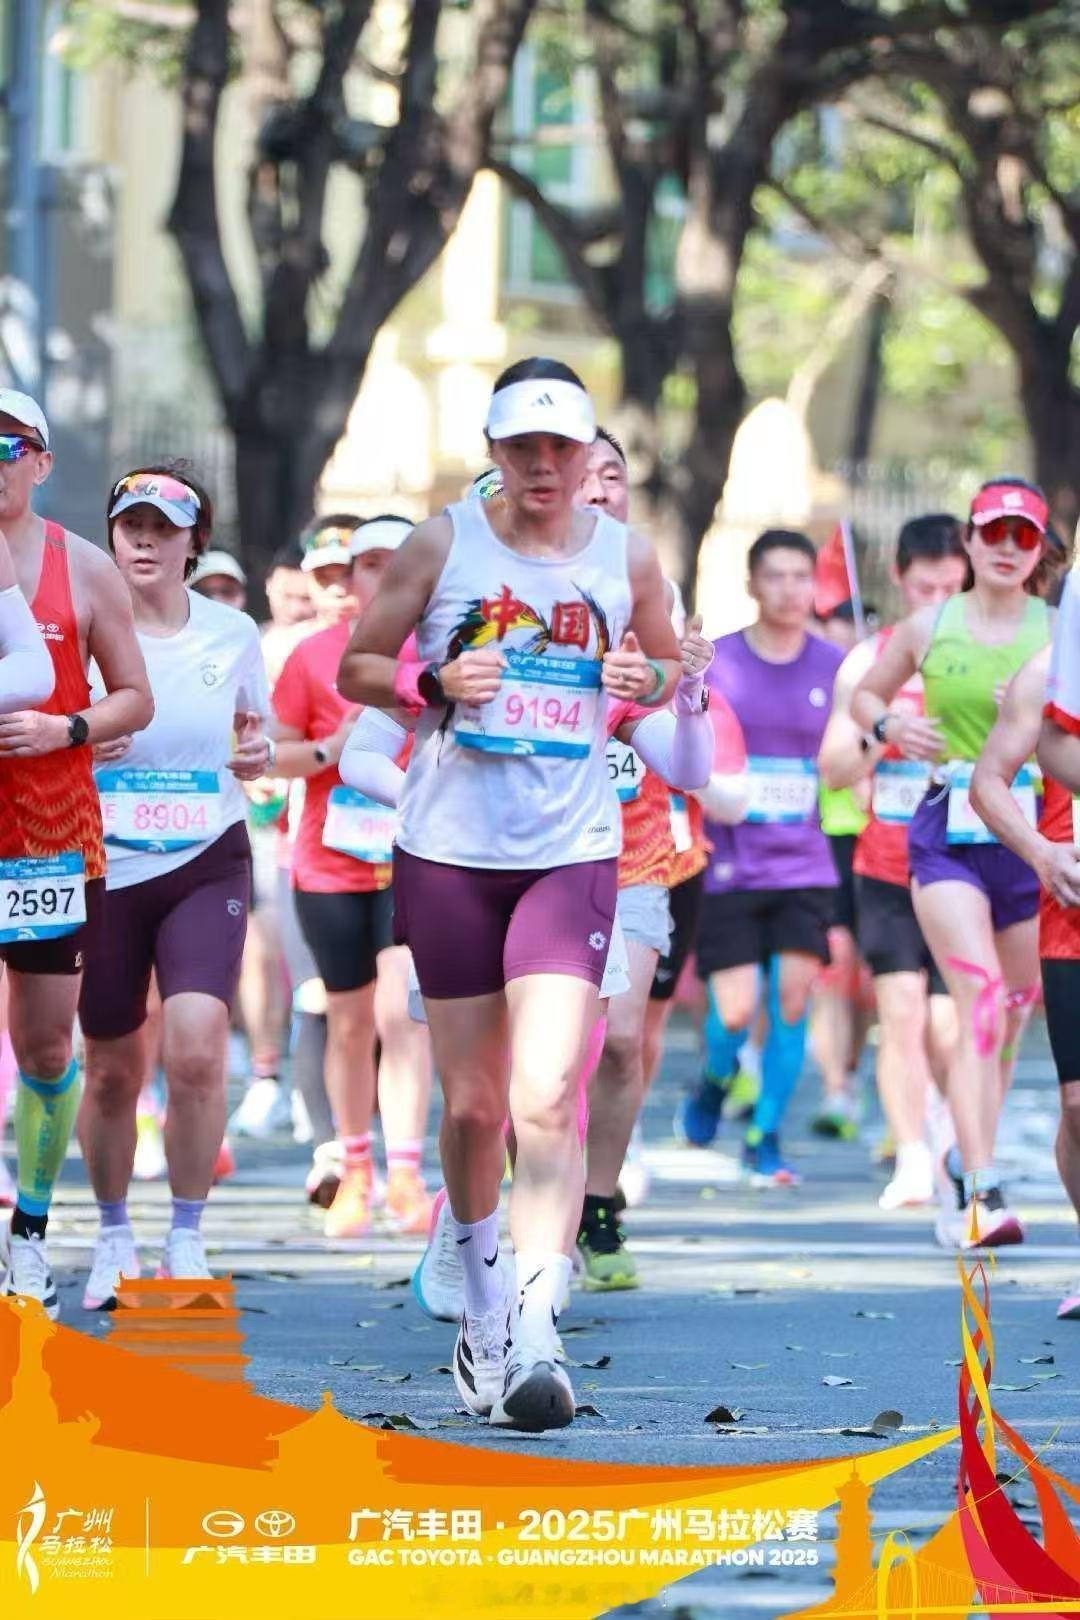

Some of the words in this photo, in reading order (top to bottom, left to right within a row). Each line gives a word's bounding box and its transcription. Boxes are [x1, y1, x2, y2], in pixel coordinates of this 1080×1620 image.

[481, 584, 590, 652] 中国
[505, 693, 581, 732] 9194
[133, 804, 208, 830] 8904
[7, 888, 75, 918] 2597
